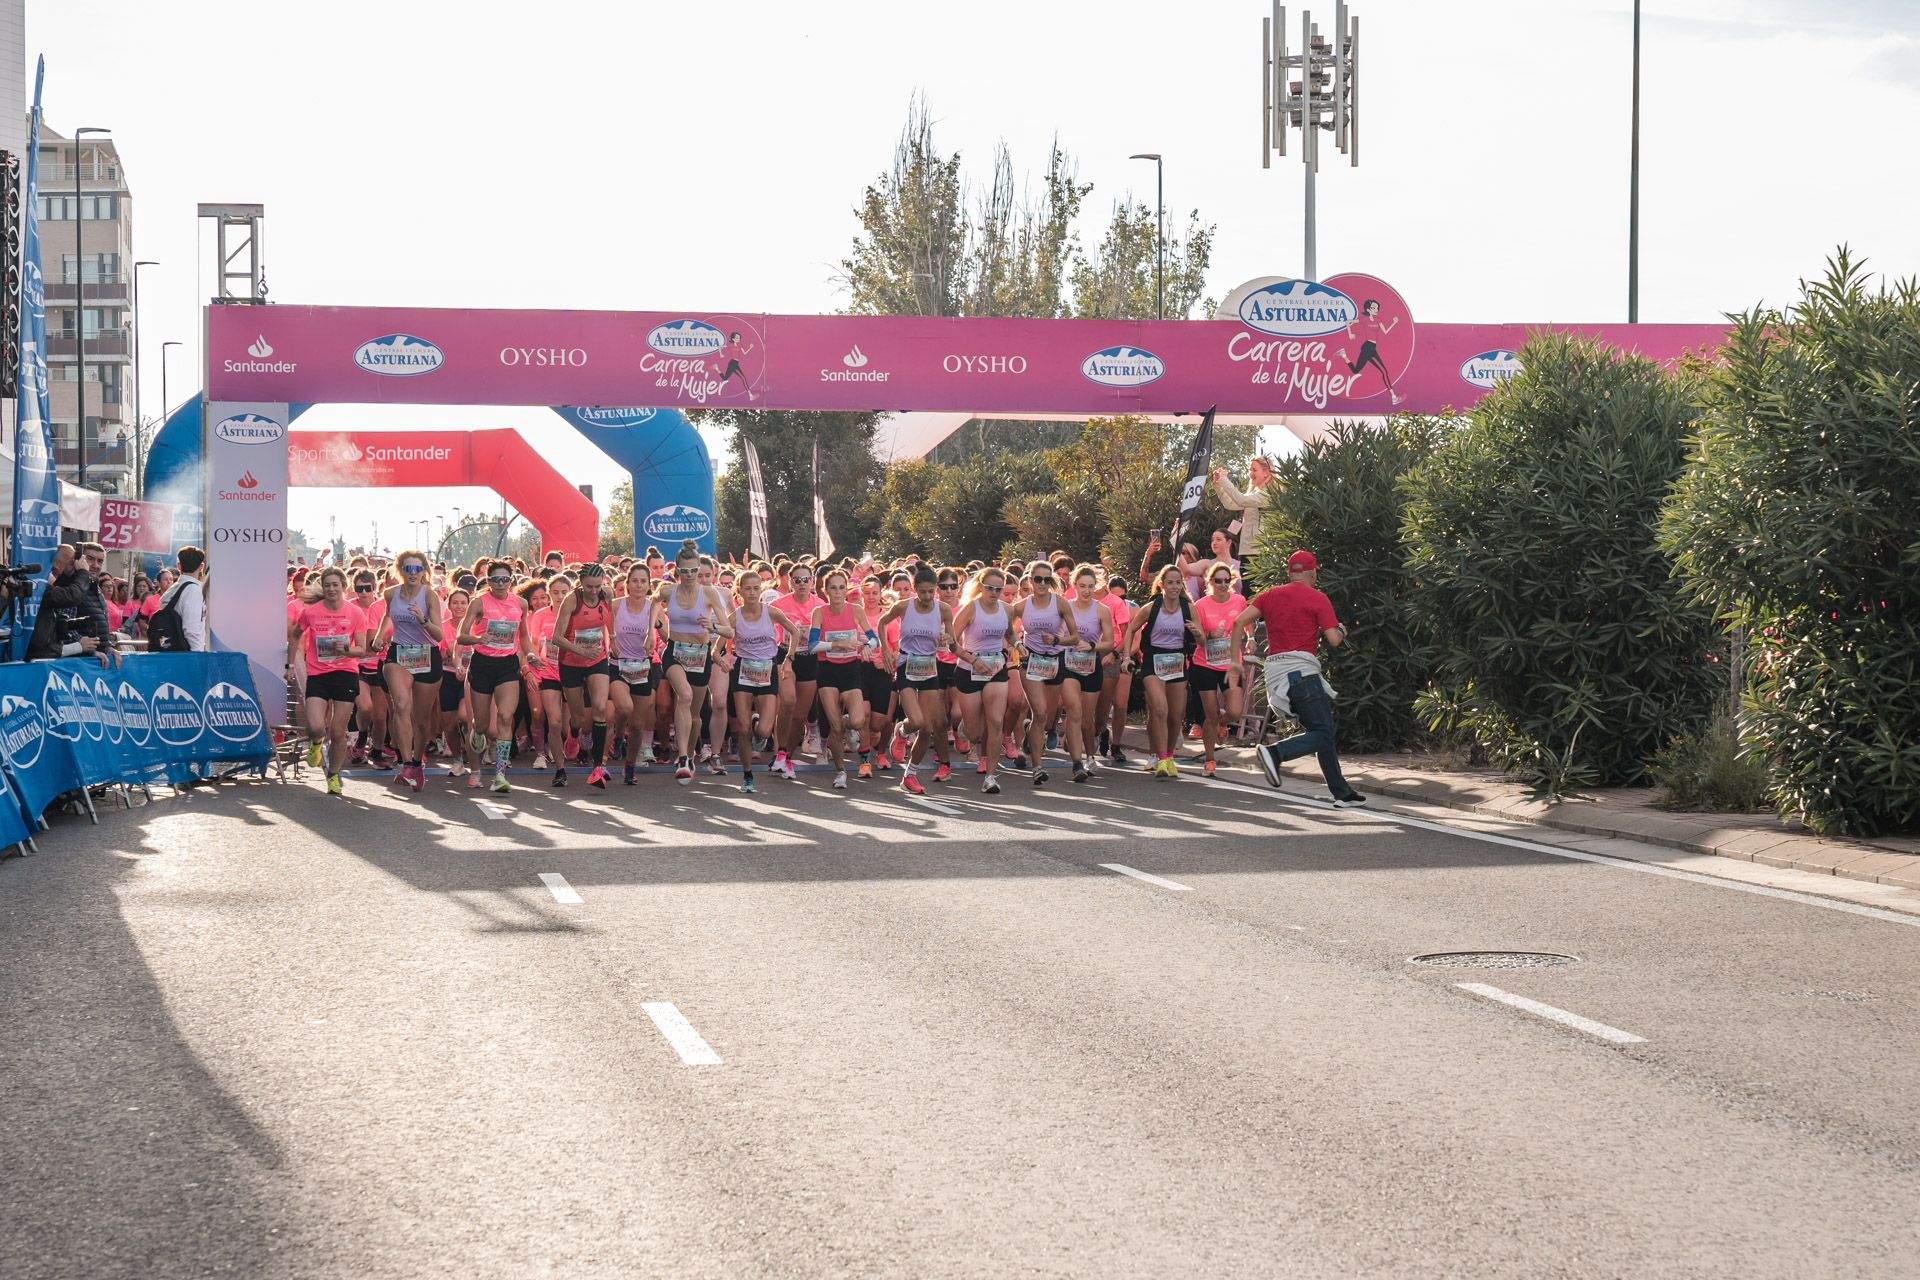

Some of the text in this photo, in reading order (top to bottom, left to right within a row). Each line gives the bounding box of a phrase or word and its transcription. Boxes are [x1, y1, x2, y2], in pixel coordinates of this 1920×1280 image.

[1248, 300, 1348, 322] ASTURIANA
[653, 332, 720, 347] ASTURIANA
[1227, 331, 1326, 362] Carrera
[224, 359, 297, 373] Santander
[361, 348, 438, 366] ASTURIANA
[500, 347, 588, 367] OYSHO
[639, 353, 705, 373] Carrera
[943, 354, 1027, 374] OYSHO
[820, 369, 890, 382] Santander
[1088, 360, 1159, 376] ASTURIANA
[1467, 364, 1522, 379] ASTURI
[655, 371, 729, 403] de la Mujer
[1252, 360, 1362, 409] de la Mujer
[584, 407, 652, 419] ASTURIANA
[220, 425, 279, 438] ASTURIANA
[288, 445, 452, 464] Sports Santander
[218, 490, 277, 501] Santander
[105, 502, 140, 519] SUB
[102, 522, 142, 544] 25'
[214, 527, 283, 543] OYSHO
[648, 519, 708, 533] ASTURIANA
[156, 705, 202, 729] ASTURIANA
[208, 705, 260, 727] ASTURIANA
